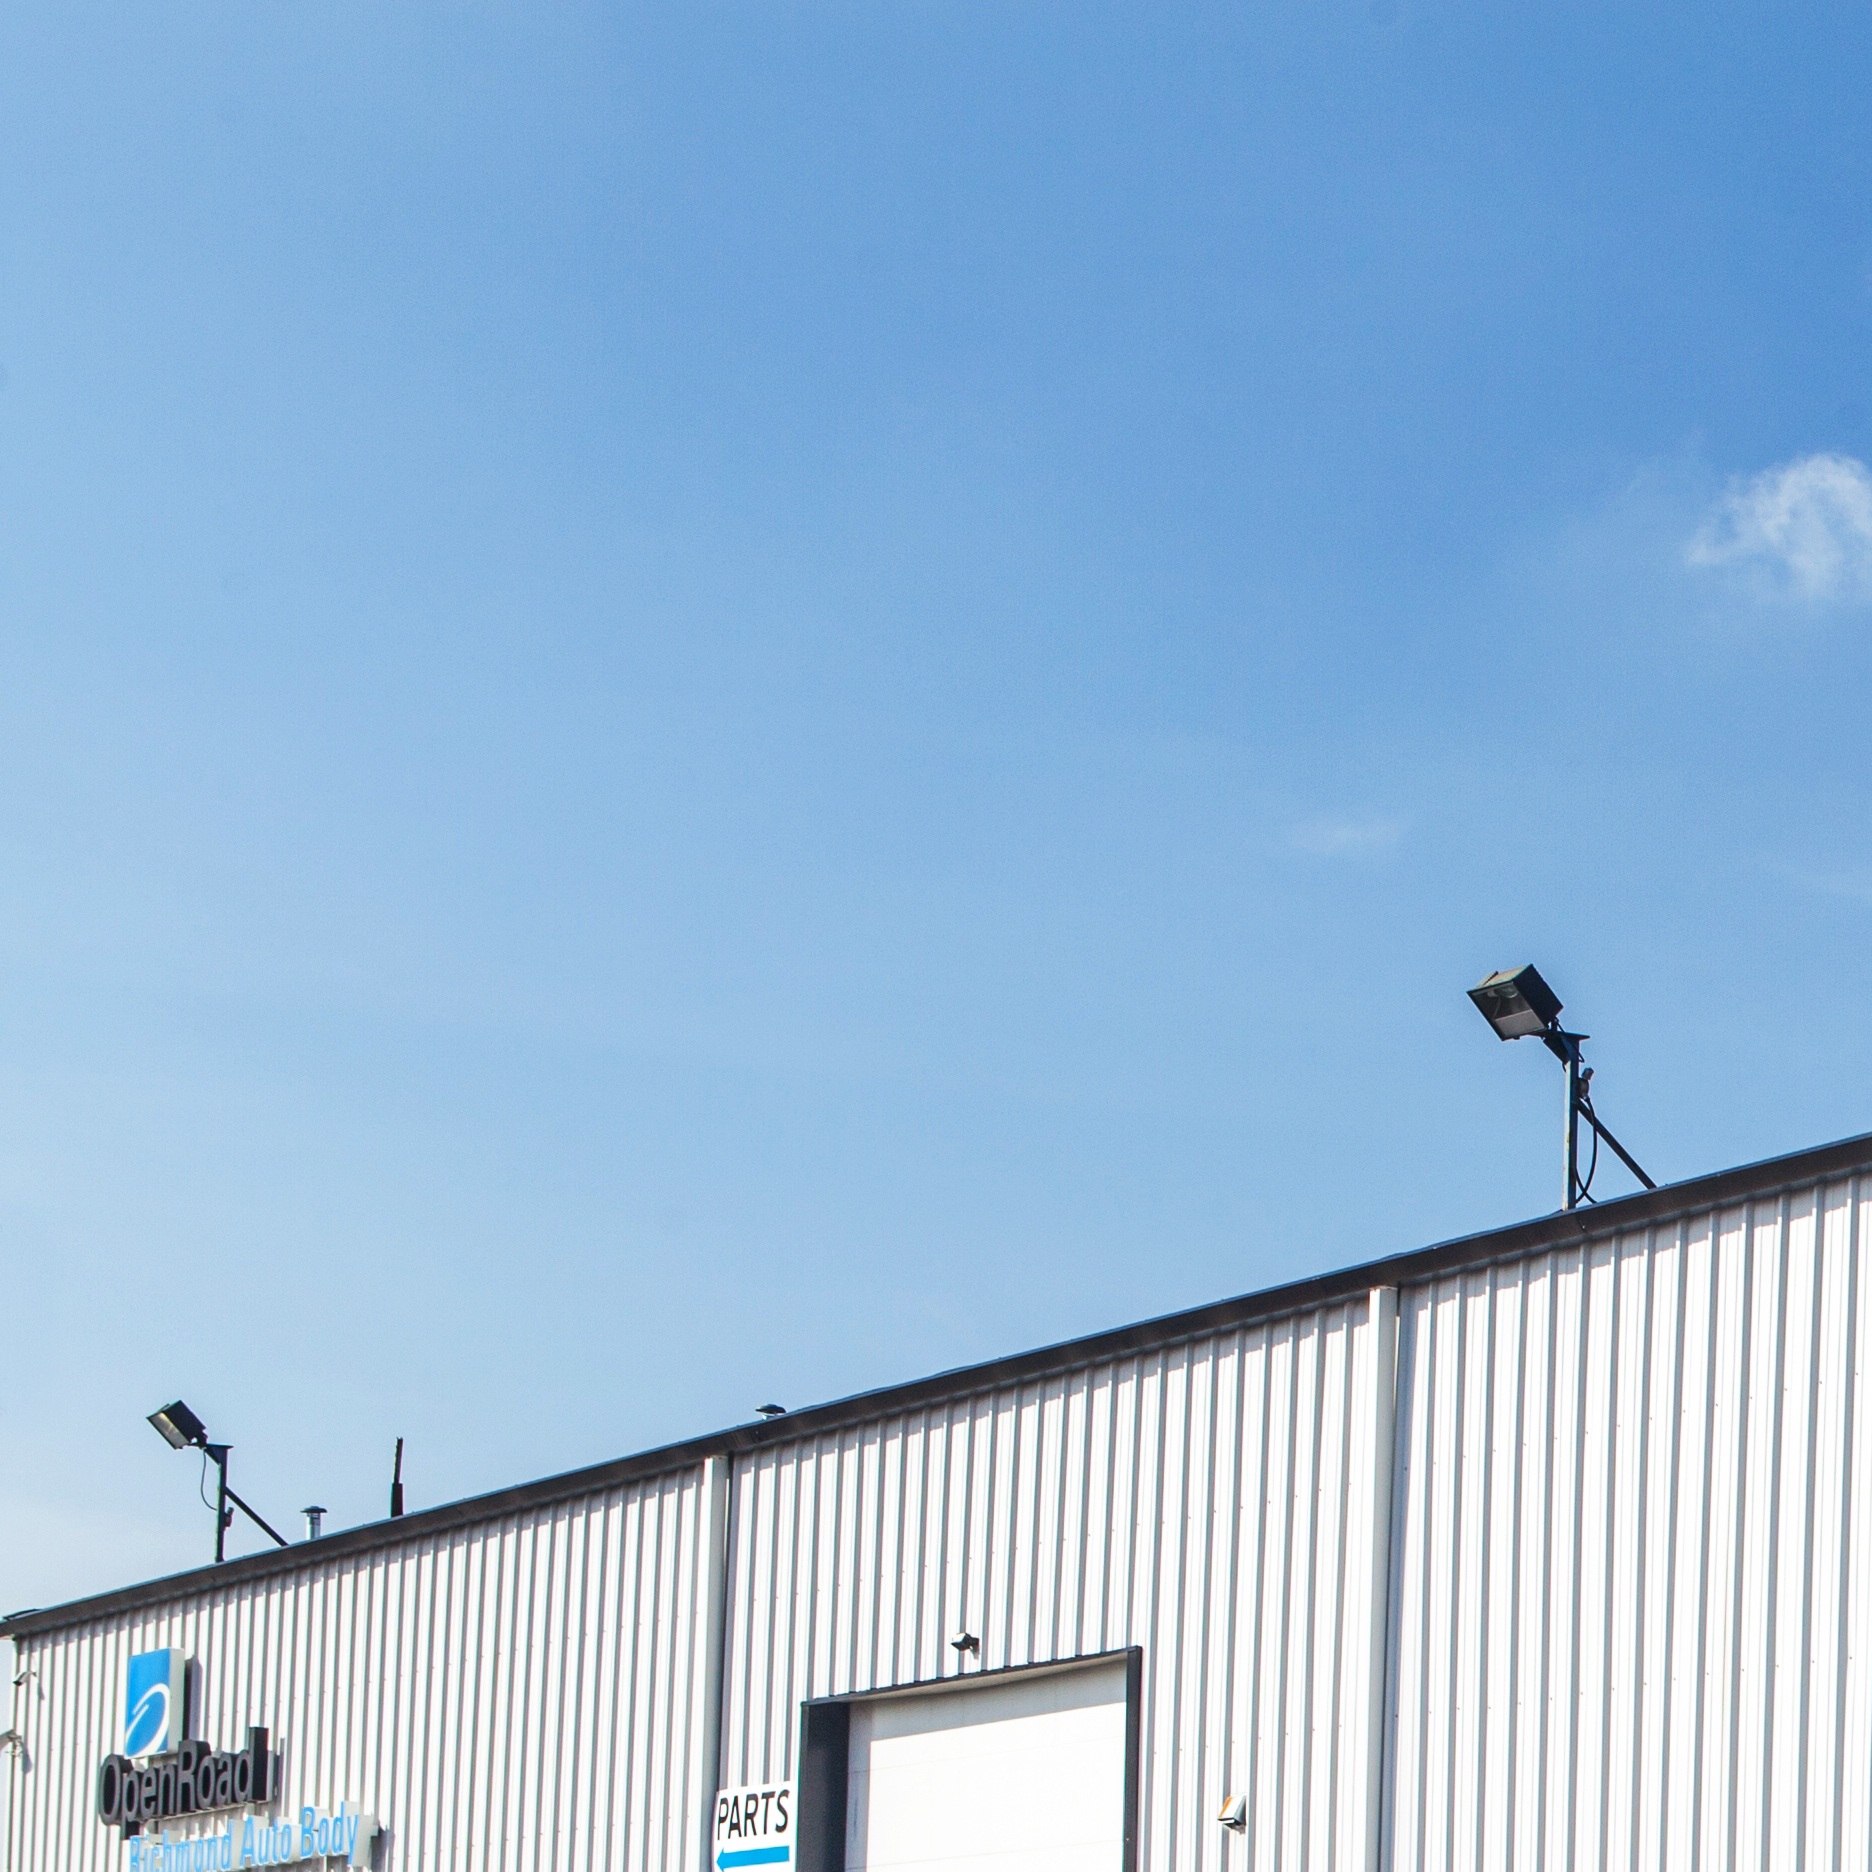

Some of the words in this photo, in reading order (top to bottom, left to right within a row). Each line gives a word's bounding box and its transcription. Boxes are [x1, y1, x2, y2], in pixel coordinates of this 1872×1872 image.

[99, 1727, 270, 1840] OpenRoad
[717, 1789, 790, 1841] PARTS
[239, 1815, 294, 1868] Auto
[300, 1800, 364, 1867] Body
